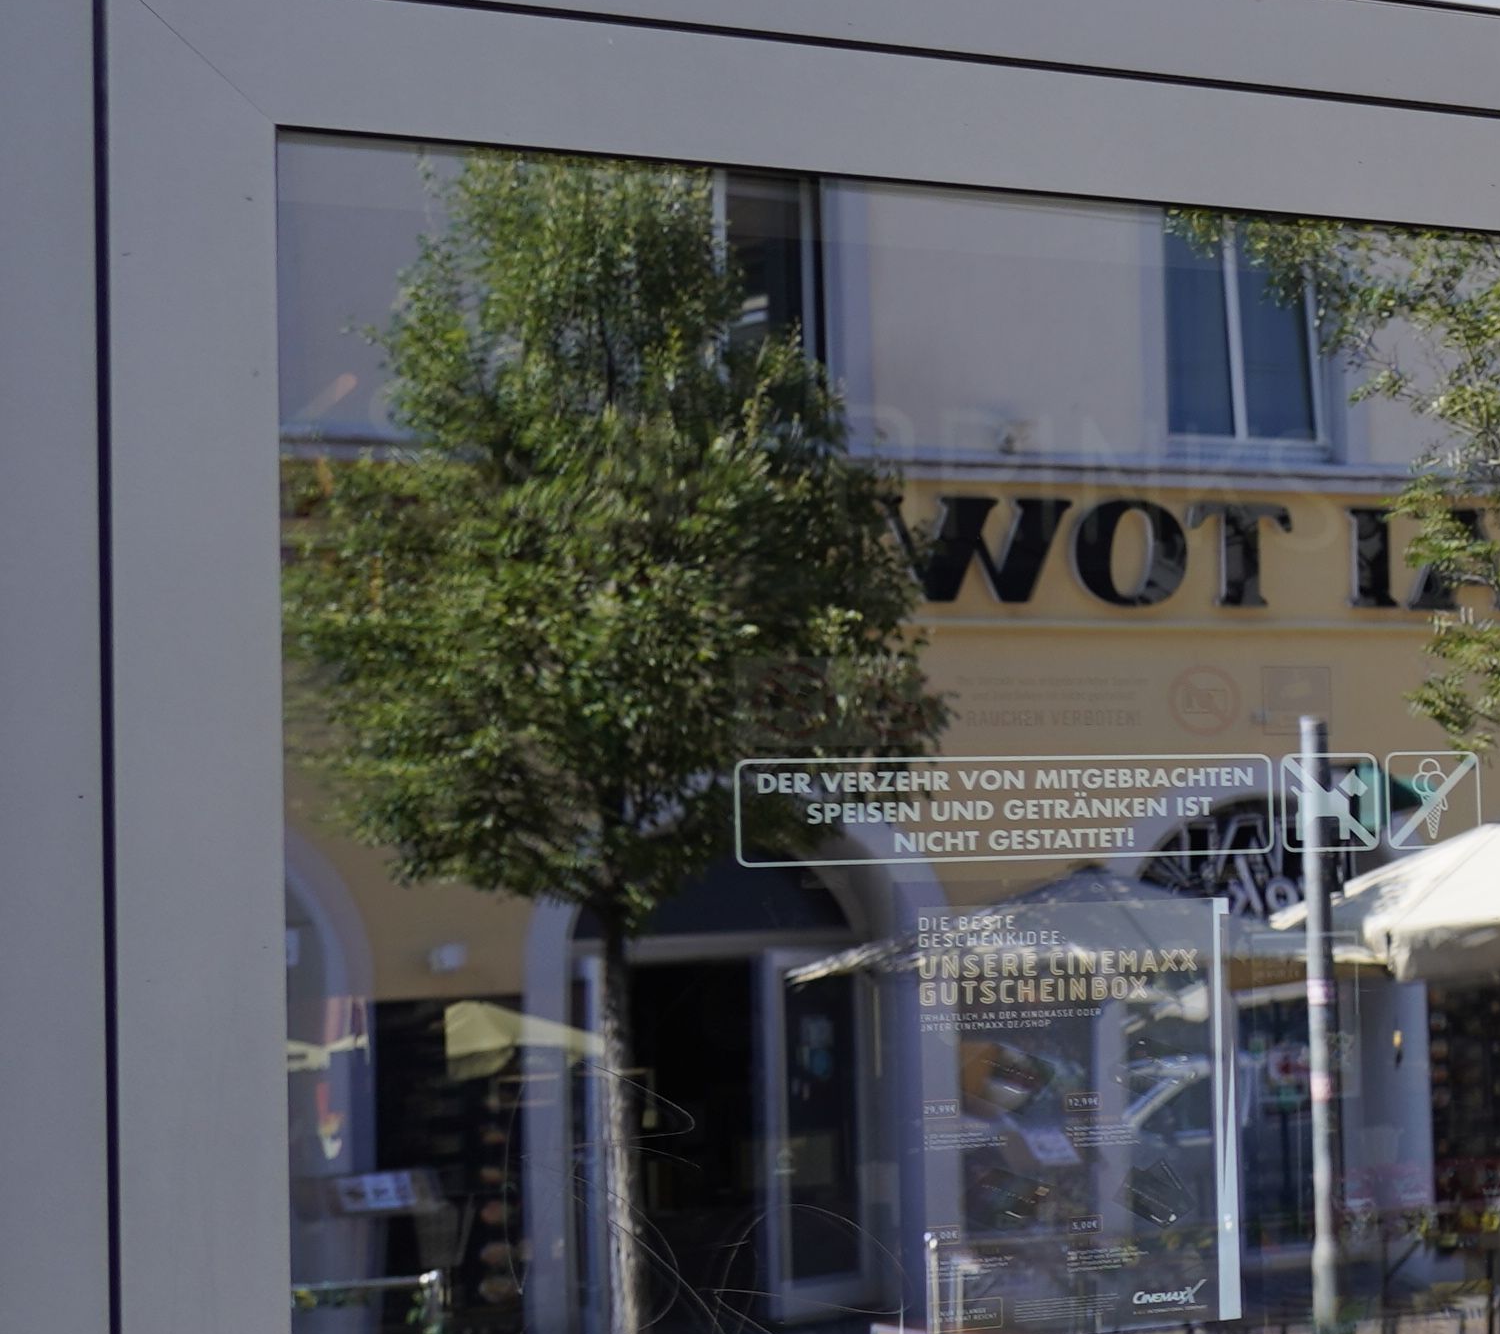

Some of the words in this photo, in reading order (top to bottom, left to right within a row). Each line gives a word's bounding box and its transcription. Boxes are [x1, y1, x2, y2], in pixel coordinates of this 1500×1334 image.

[756, 772, 812, 795] DER
[821, 769, 951, 793] VERZEHR
[959, 768, 1025, 791] VON
[1035, 766, 1254, 790] MITGEBRACHTEN
[806, 801, 922, 825] SPEISEN
[930, 799, 995, 823] UND
[1004, 792, 1168, 820] GETRÄNKEN
[1176, 795, 1213, 817] IST
[893, 830, 981, 854] NICHT
[988, 827, 1135, 852] GESTATTET!
[917, 916, 951, 933] DIE
[957, 915, 1017, 932] BESTE
[917, 930, 1067, 949] GESCHENKIDEE:
[919, 951, 1039, 980] UNSERE
[1049, 947, 1200, 977] CINEMAXX
[918, 974, 1149, 1008] GUTSCHEINBOX
[982, 1011, 996, 1021] AN
[999, 1009, 1018, 1021] DER
[1021, 1008, 1074, 1020] KINOKASSE
